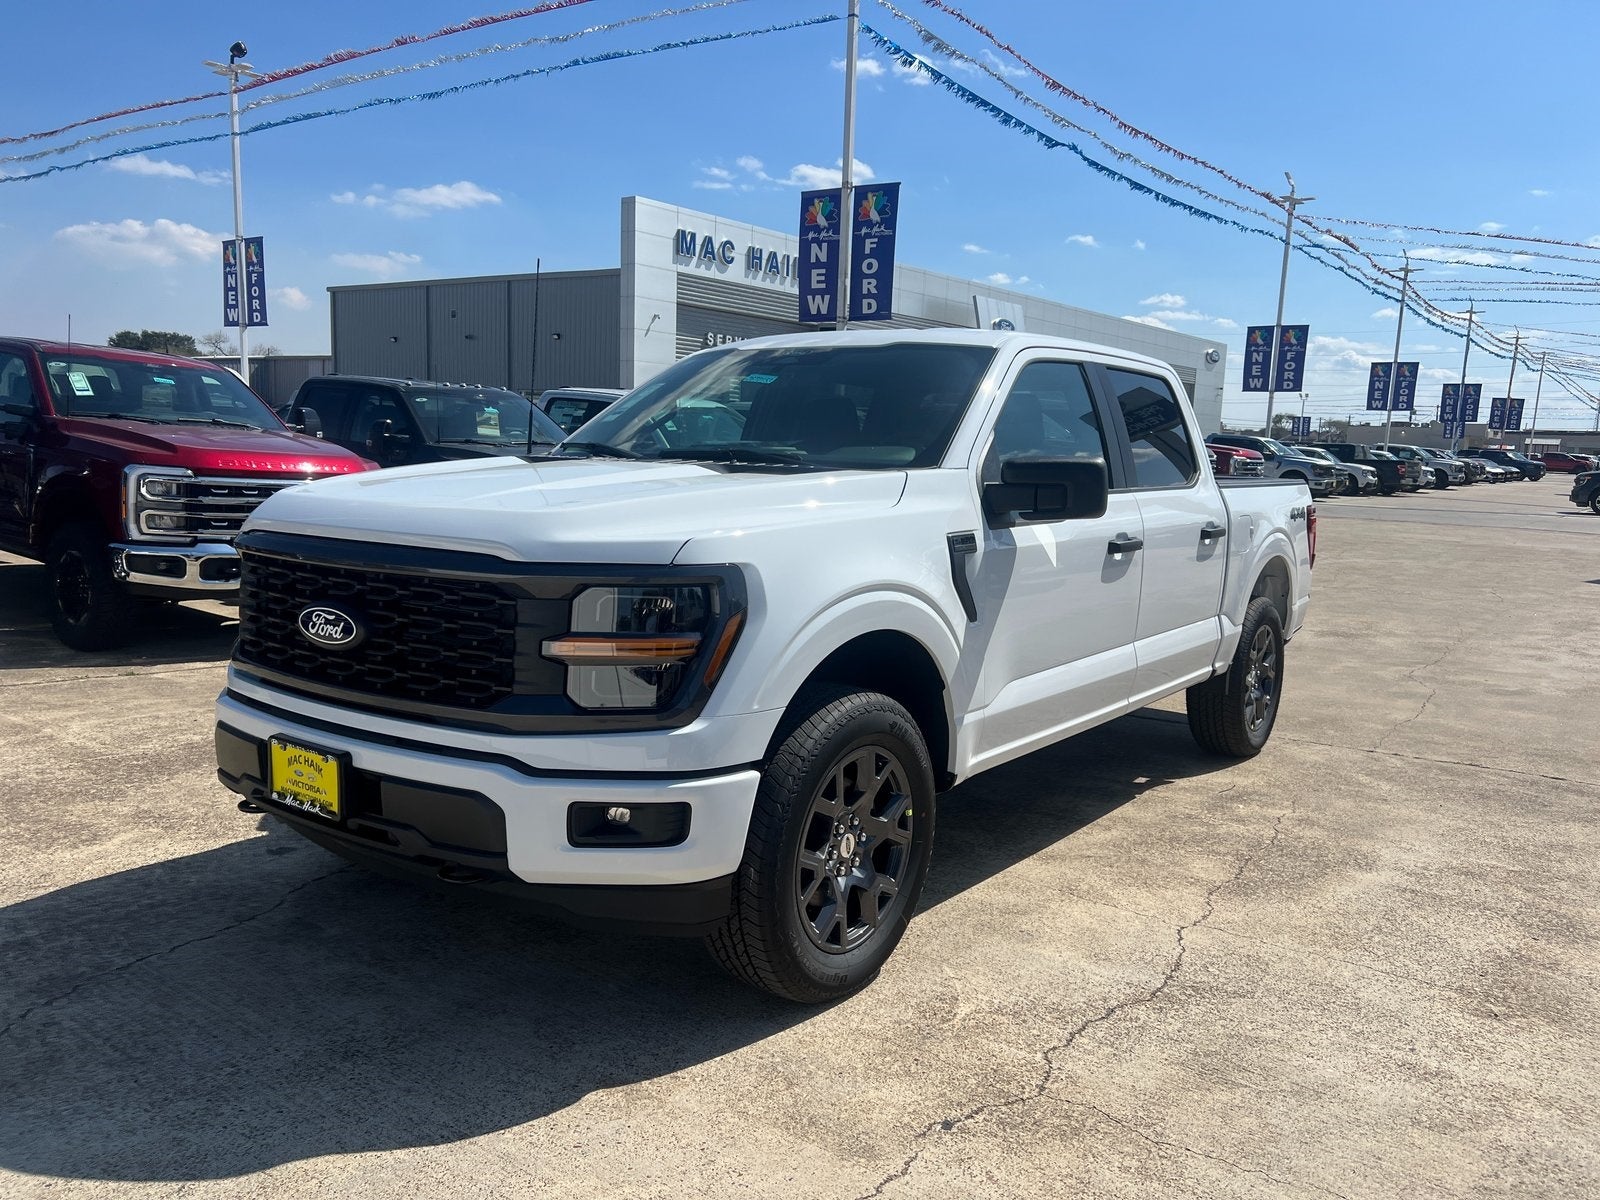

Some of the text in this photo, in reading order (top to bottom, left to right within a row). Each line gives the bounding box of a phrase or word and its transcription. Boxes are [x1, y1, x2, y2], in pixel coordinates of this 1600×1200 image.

[677, 228, 799, 280] MAC HAI
[807, 242, 831, 315] NEW
[861, 238, 879, 315] FORD
[227, 274, 239, 322] NEW
[251, 273, 261, 323] FORD
[1249, 352, 1263, 389] NEW
[1282, 351, 1296, 390] FORD
[1371, 381, 1384, 409] NEW
[1398, 381, 1409, 409] FORD
[1443, 398, 1454, 420] NEW
[1465, 398, 1474, 421] FORD
[1492, 410, 1501, 428] NEW
[1509, 410, 1518, 429] FORD
[308, 611, 345, 639] Ford
[287, 754, 303, 768] MAC
[303, 756, 324, 778] HAIK
[292, 779, 322, 795] VICTORIA
